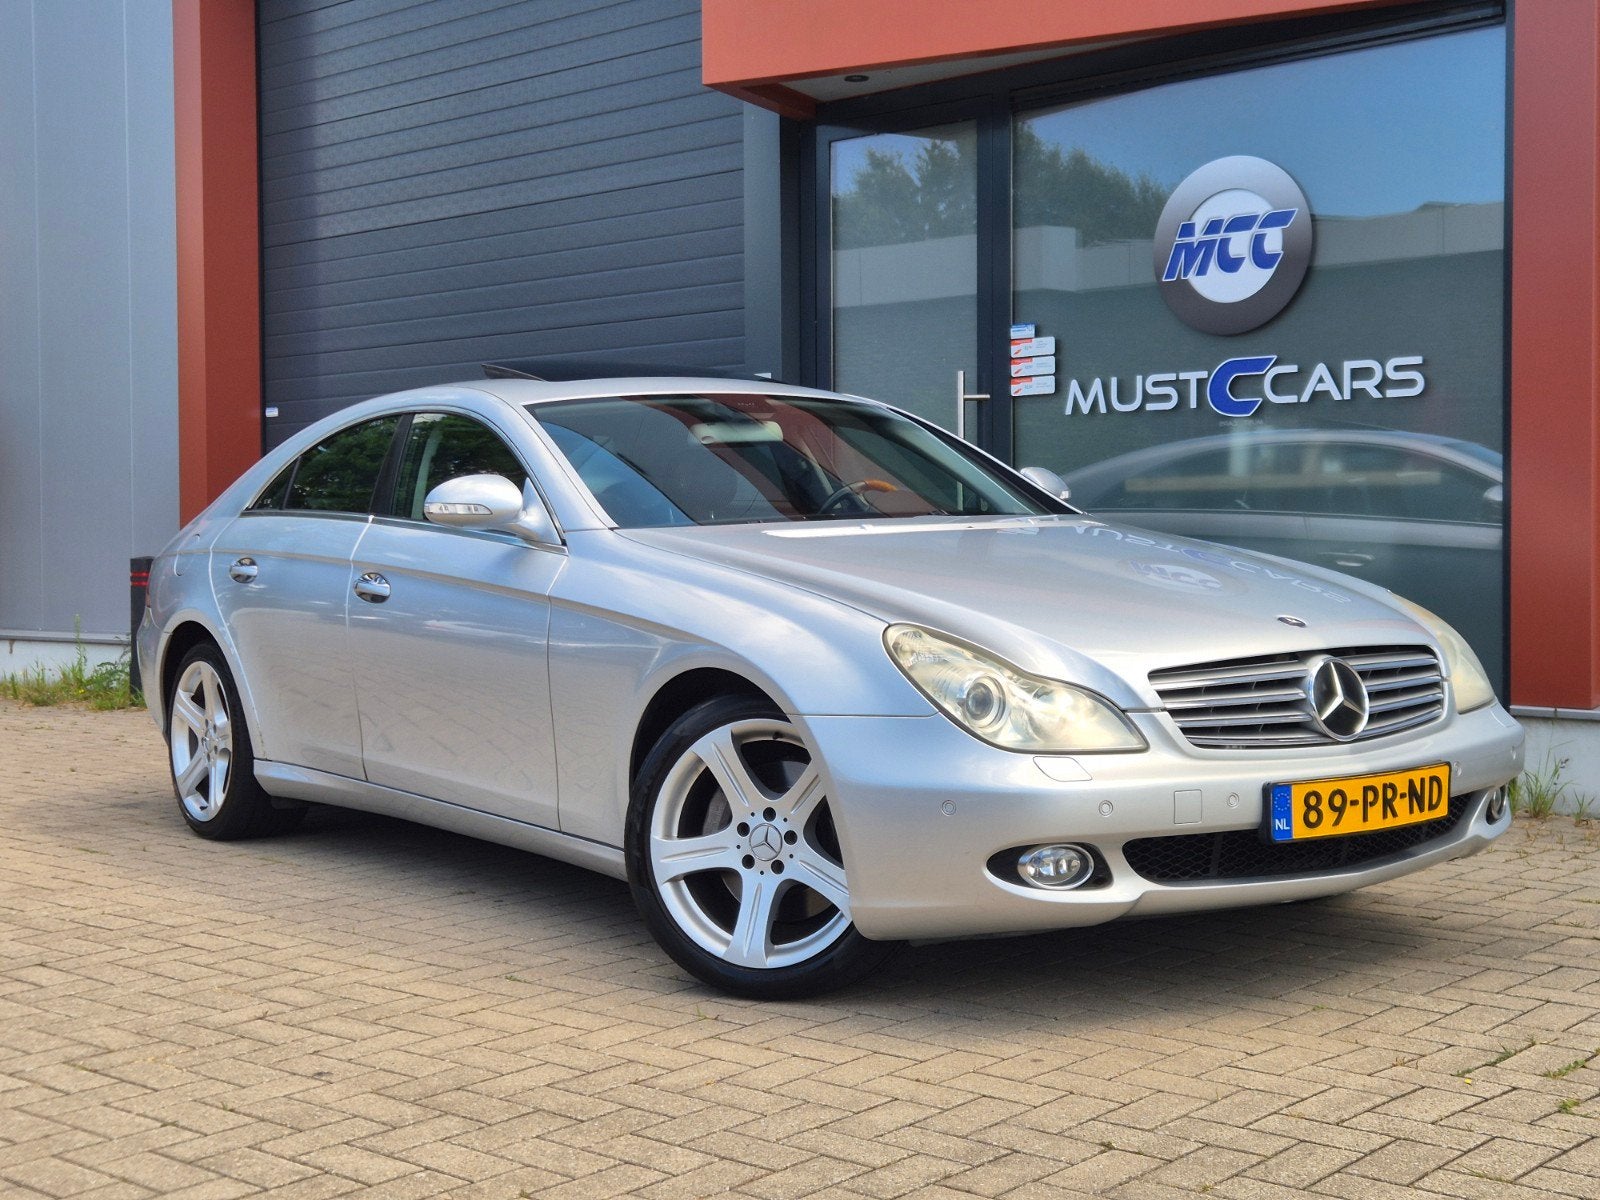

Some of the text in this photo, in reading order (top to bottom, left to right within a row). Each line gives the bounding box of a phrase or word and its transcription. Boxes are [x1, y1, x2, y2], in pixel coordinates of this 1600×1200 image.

[1162, 208, 1298, 281] MCC
[1275, 818, 1291, 831] NL
[1302, 775, 1443, 829] 89-PR-ND
